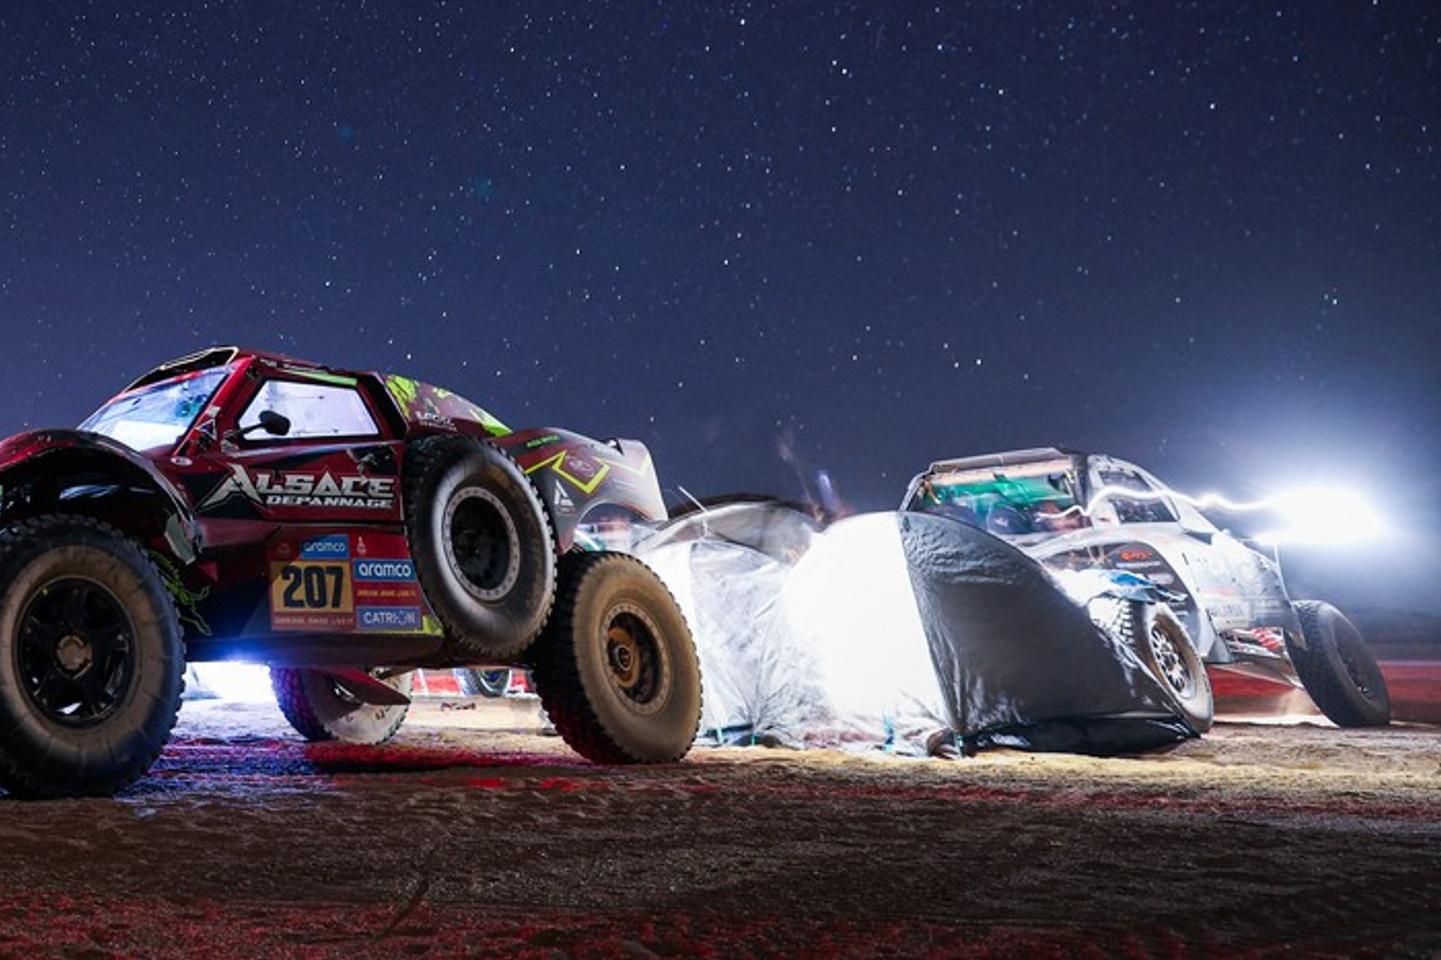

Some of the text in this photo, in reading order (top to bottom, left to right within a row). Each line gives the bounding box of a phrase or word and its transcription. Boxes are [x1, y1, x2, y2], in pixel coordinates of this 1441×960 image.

[201, 463, 395, 507] ALSACE
[266, 495, 393, 508] DEPANNAGE
[303, 541, 346, 553] aramco
[358, 562, 411, 577] aramco
[281, 565, 344, 609] 207
